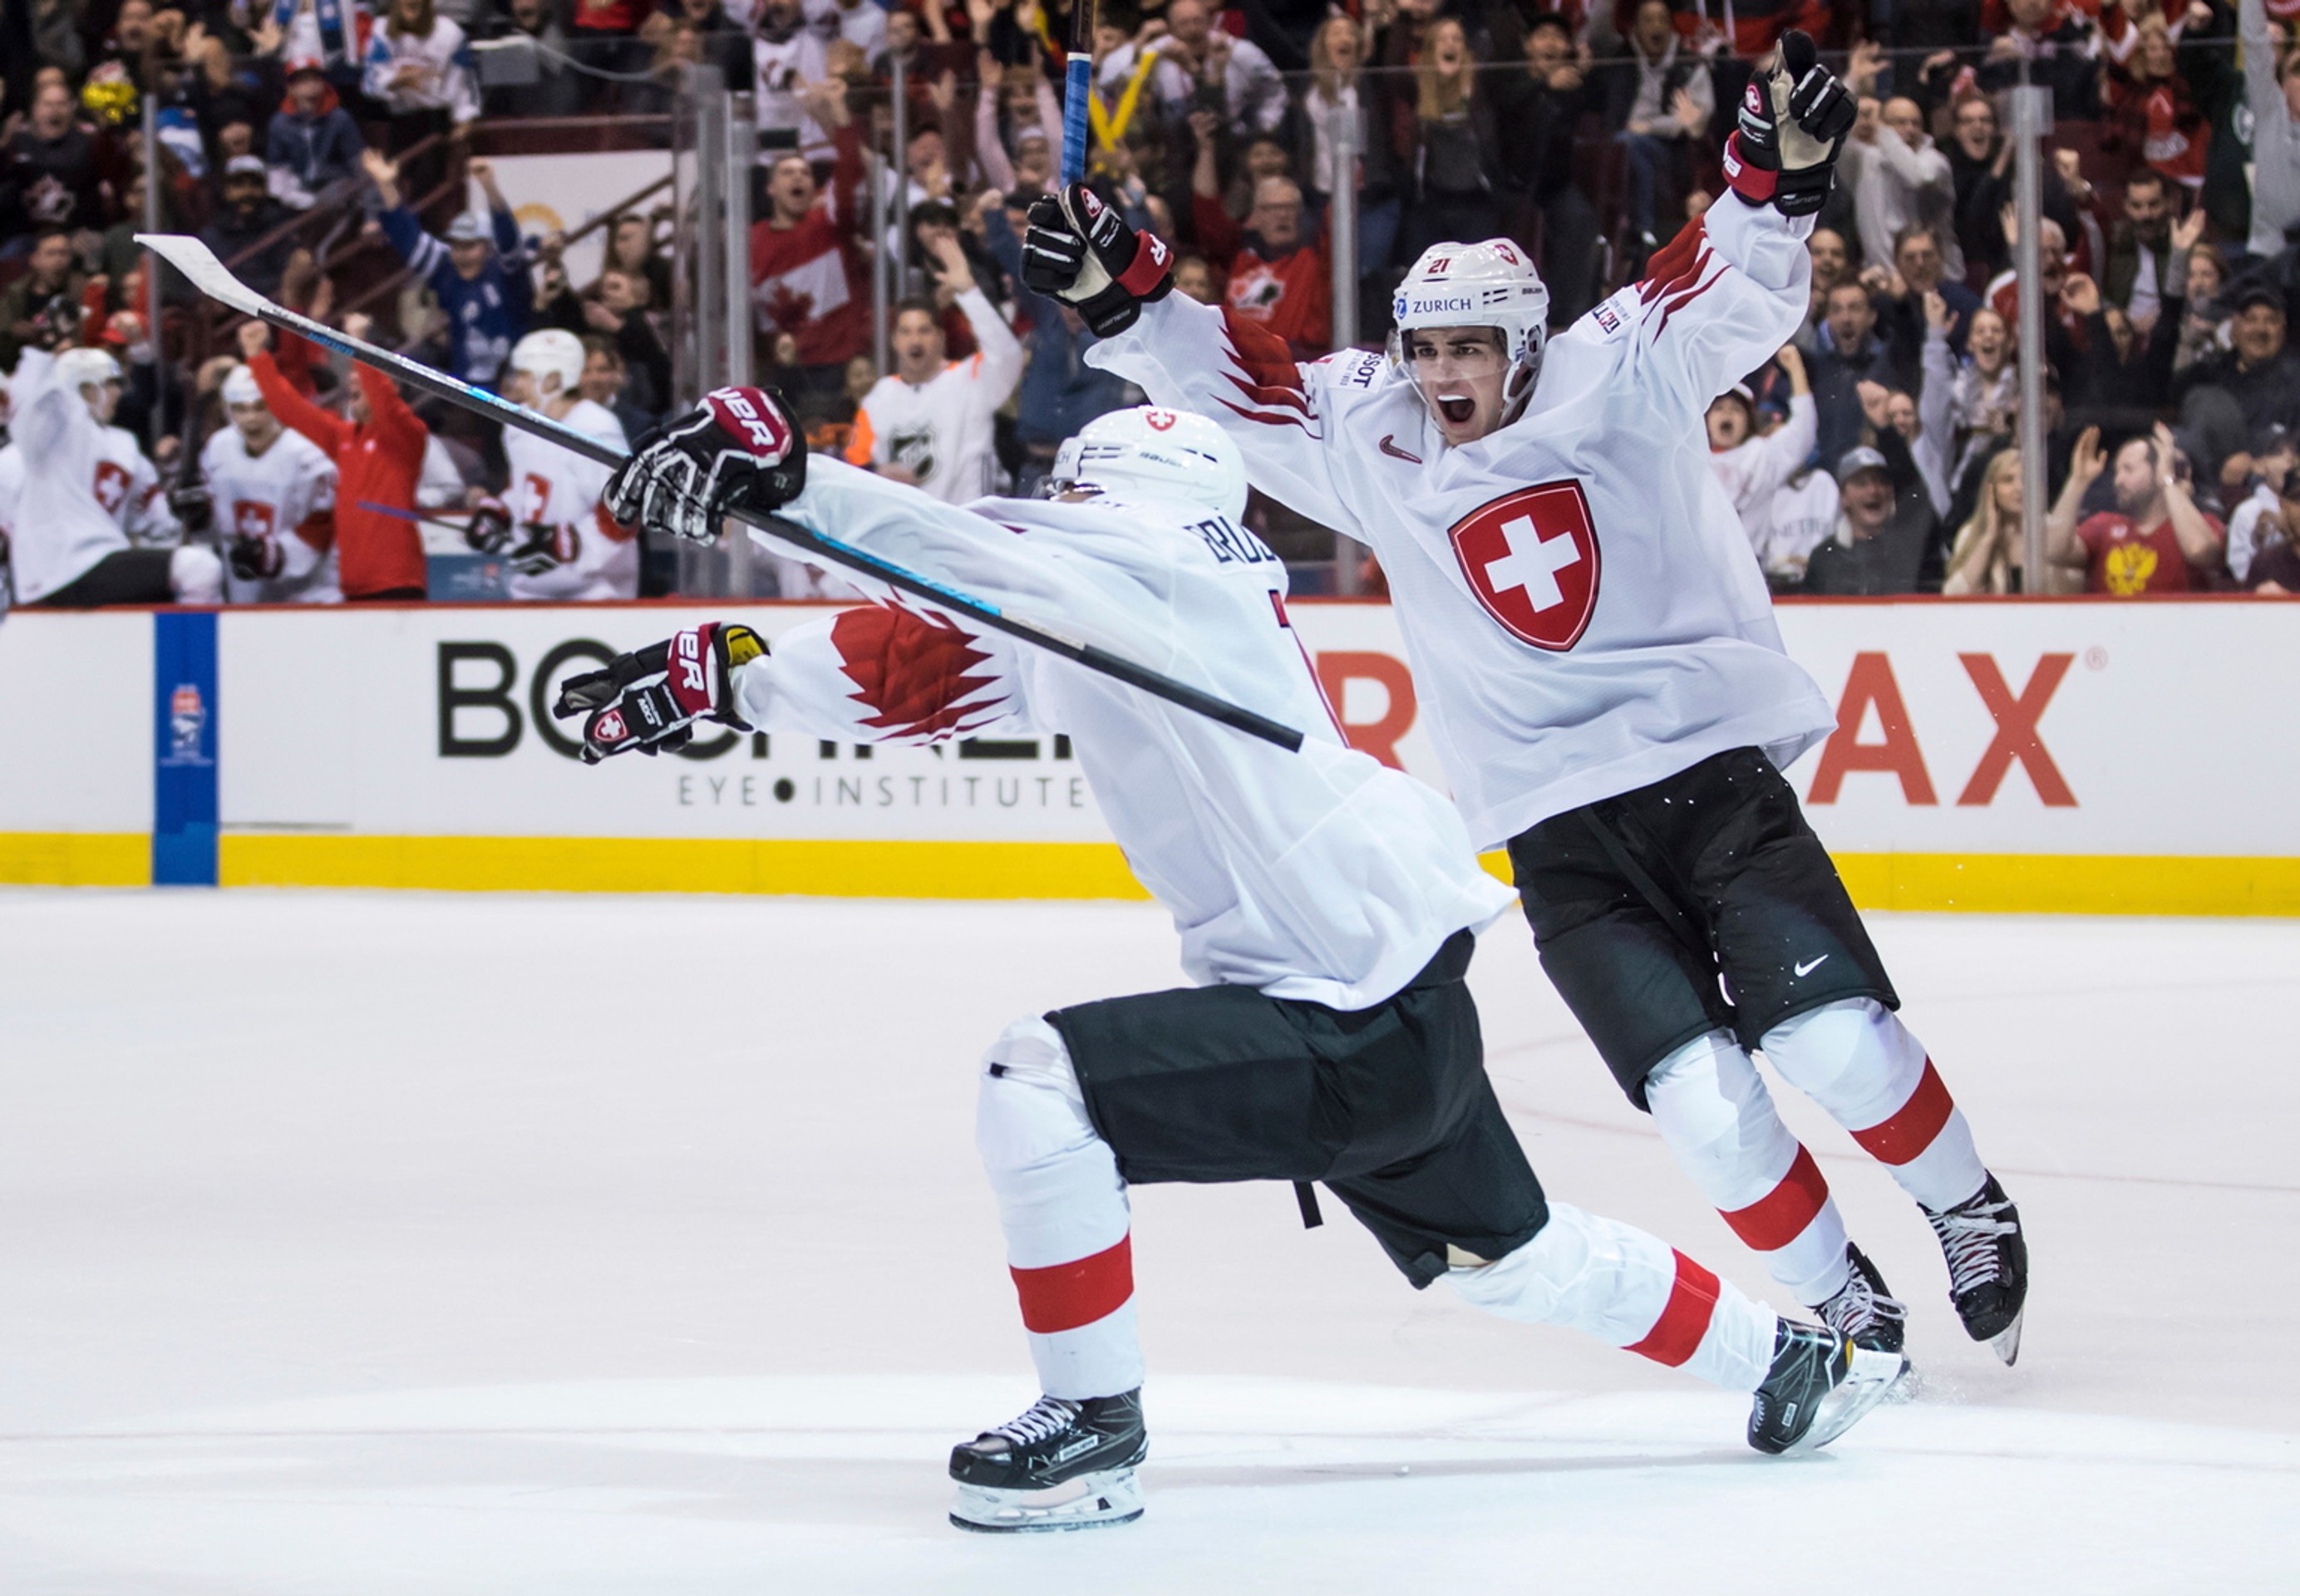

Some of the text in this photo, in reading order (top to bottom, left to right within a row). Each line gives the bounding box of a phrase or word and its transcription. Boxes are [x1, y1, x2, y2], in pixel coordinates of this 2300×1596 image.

[1427, 258, 1451, 273] 21
[1413, 298, 1471, 313] ZURICH
[1353, 353, 1384, 388] SSOT
[678, 775, 1084, 807] EYE INSTITUTE
